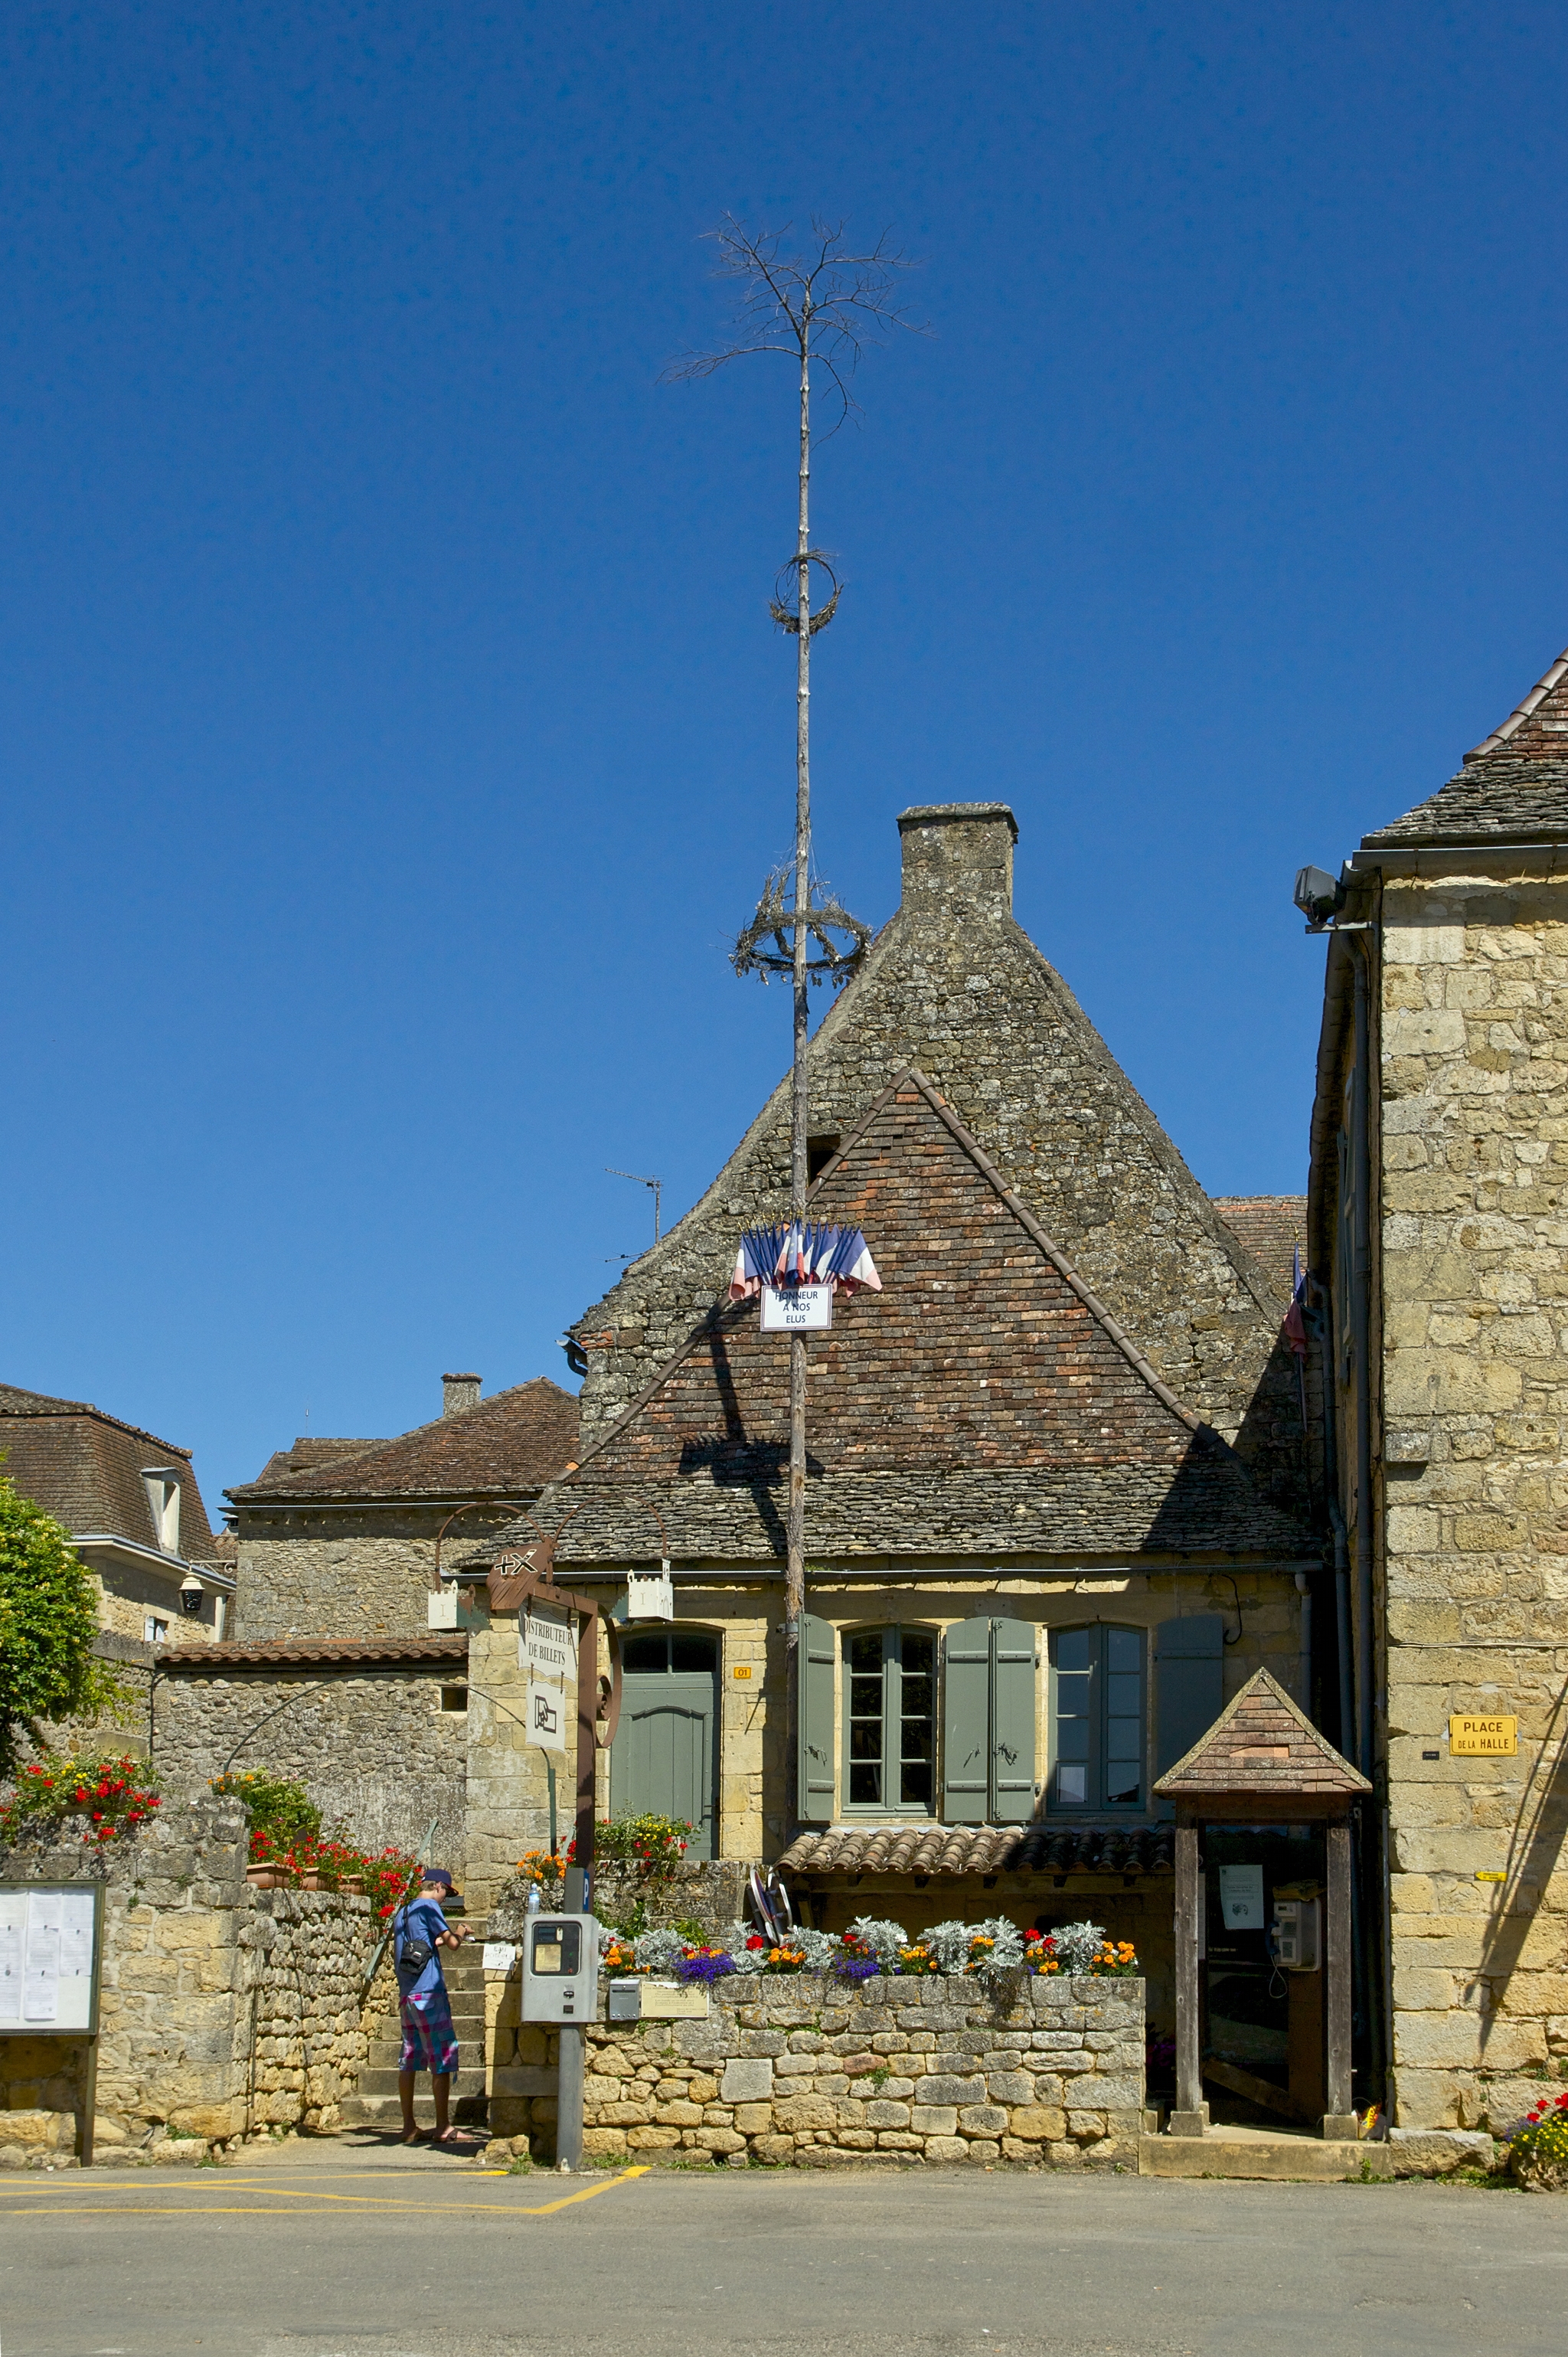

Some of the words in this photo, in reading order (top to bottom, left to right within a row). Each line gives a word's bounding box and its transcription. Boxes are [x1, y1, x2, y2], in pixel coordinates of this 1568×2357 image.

[775, 1290, 818, 1300] HONNEUR
[782, 1304, 789, 1313] A
[792, 1303, 811, 1312] NOS
[786, 1315, 806, 1324] ELUS
[524, 1617, 573, 1646] DISTRIBUTEUR
[528, 1642, 538, 1658] DE
[539, 1645, 566, 1666] BILLETS
[1463, 1721, 1504, 1732] PLACE
[1458, 1740, 1466, 1749] DE
[1468, 1740, 1476, 1749] LA
[1480, 1738, 1509, 1749] HALLE
[583, 1878, 590, 1905] P
